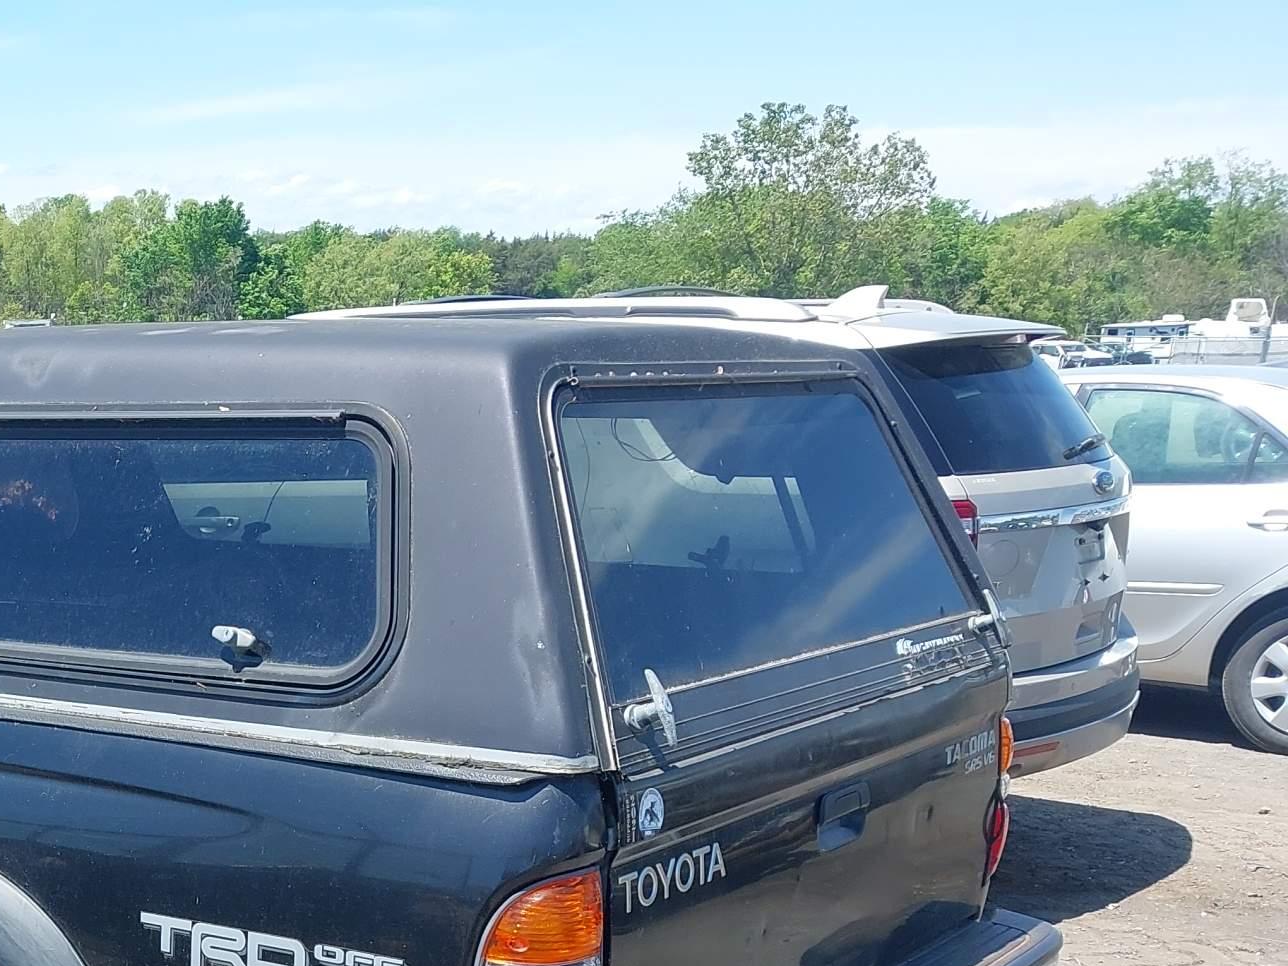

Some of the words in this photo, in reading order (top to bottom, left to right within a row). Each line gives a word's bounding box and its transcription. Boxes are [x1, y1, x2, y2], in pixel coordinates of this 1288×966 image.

[944, 729, 996, 766] TACOMA
[983, 750, 995, 766] V6
[617, 842, 727, 914] TOYOTA
